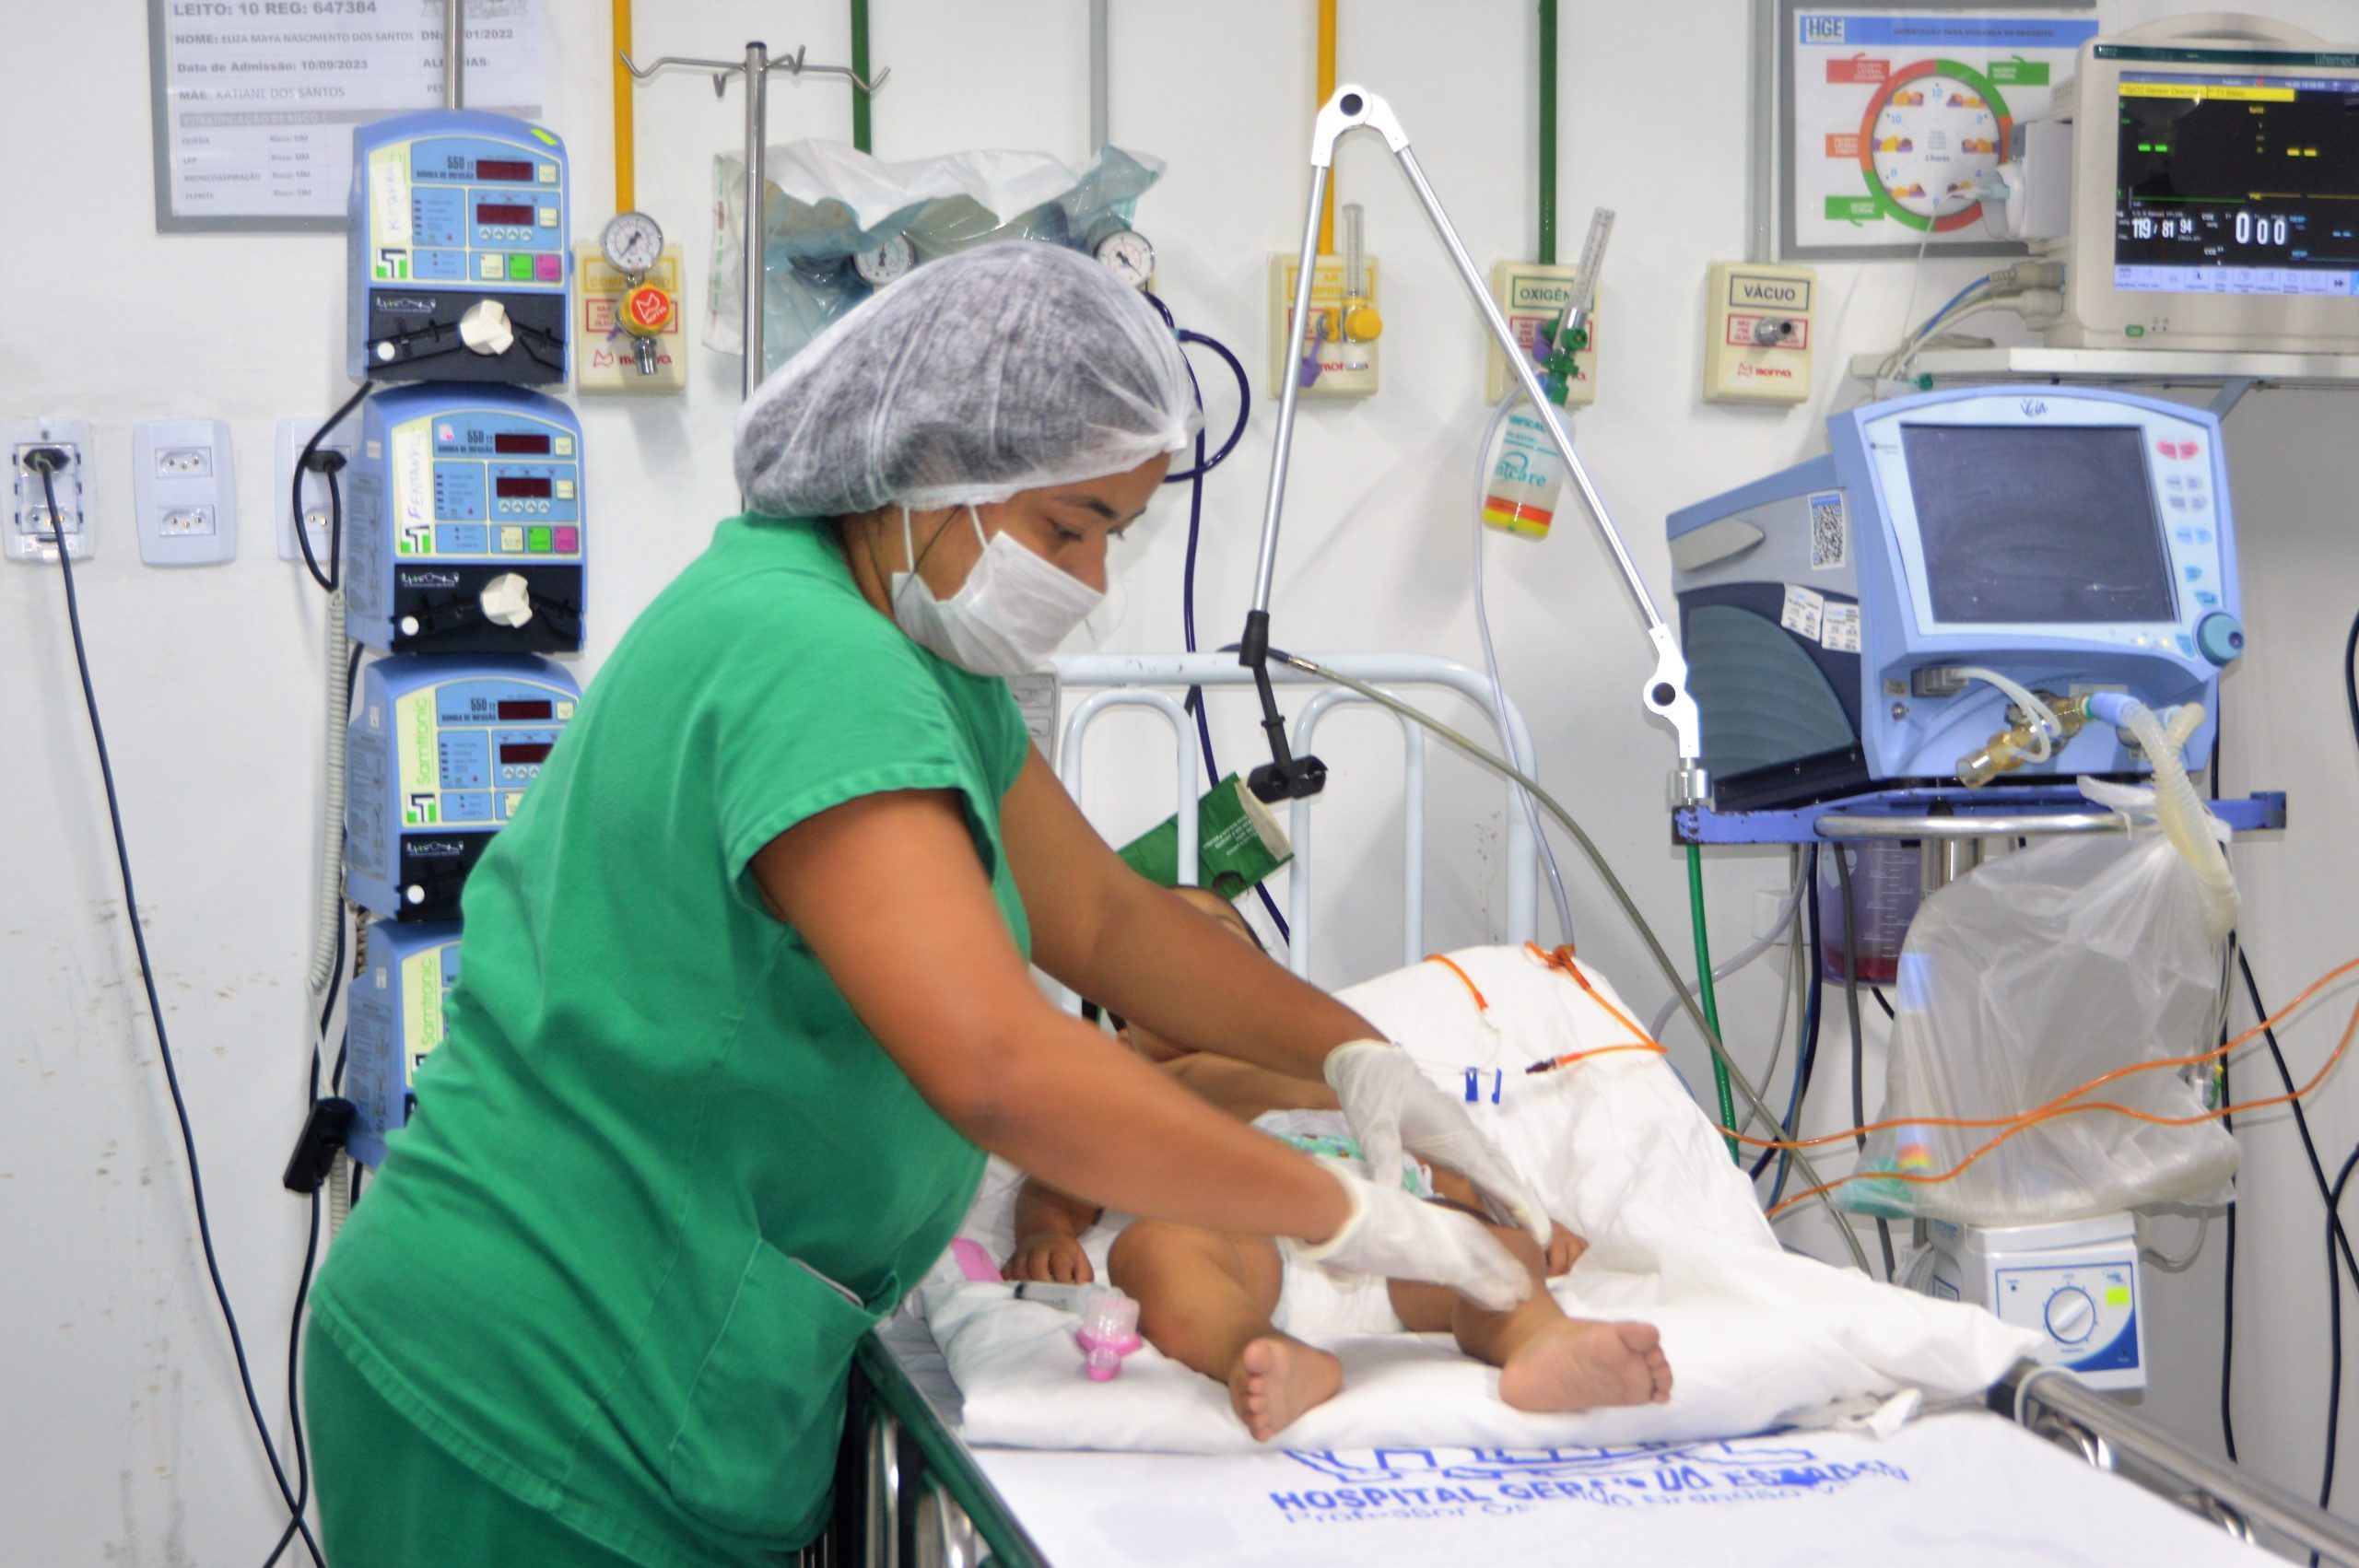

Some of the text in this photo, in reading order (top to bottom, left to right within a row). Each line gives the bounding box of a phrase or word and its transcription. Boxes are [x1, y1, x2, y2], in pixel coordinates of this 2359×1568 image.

[174, 1, 376, 17] LEITO: 10 REG: 647384
[464, 29, 513, 40] 01/2022
[1808, 18, 1843, 37] HGE
[175, 34, 218, 45] NOME:
[251, 33, 280, 43] MAYA
[284, 32, 349, 43] NASCIMENTO
[352, 32, 372, 41] DOS
[375, 31, 414, 41] SANTOS
[177, 58, 368, 73] Data de Admissão: 10/09/2023
[423, 57, 489, 68] ALIAS:
[271, 88, 295, 99] DOS
[298, 86, 346, 98] SANTOS
[448, 156, 464, 169] 550
[2131, 217, 2152, 239] 119
[2162, 219, 2175, 239] 81
[2179, 217, 2192, 234] 94
[1520, 287, 1570, 302] OXIGÊN
[1743, 283, 1796, 301] VÁCUO
[467, 430, 484, 444] 550
[471, 698, 487, 711] 550
[417, 696, 431, 786] Samtronic
[421, 957, 435, 1047] Samtronic
[1268, 1486, 1493, 1511] HOSPITAL
